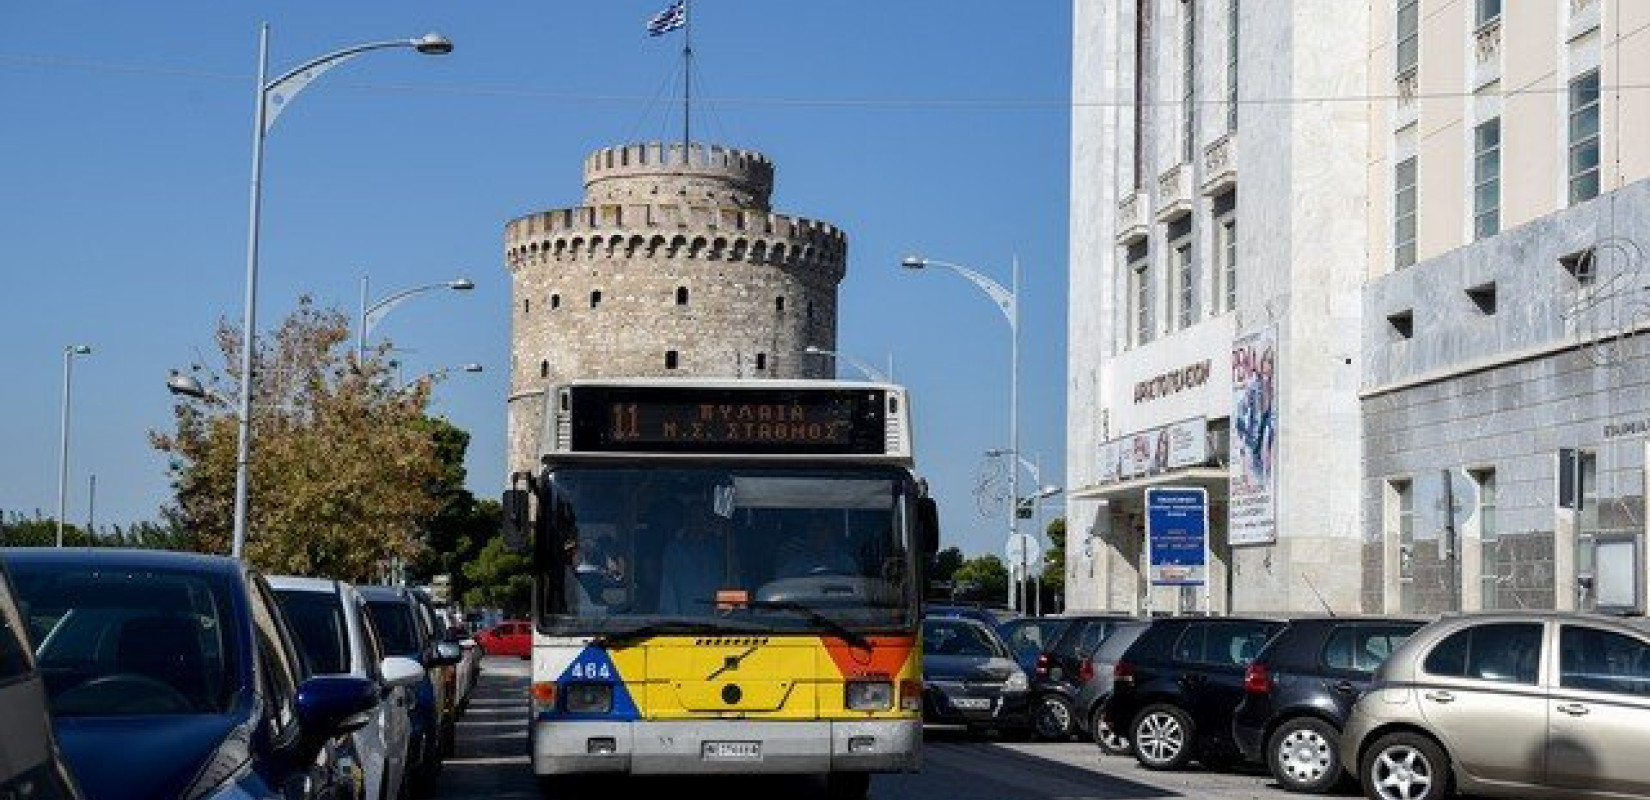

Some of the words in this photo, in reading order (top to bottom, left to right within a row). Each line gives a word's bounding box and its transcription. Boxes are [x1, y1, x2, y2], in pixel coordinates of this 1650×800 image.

[699, 404, 805, 420] ΠΥΛΑΙΑ
[613, 404, 640, 439] 11
[726, 422, 838, 440] ΣΤΑΘΜΟΣ
[571, 662, 611, 679] 464
